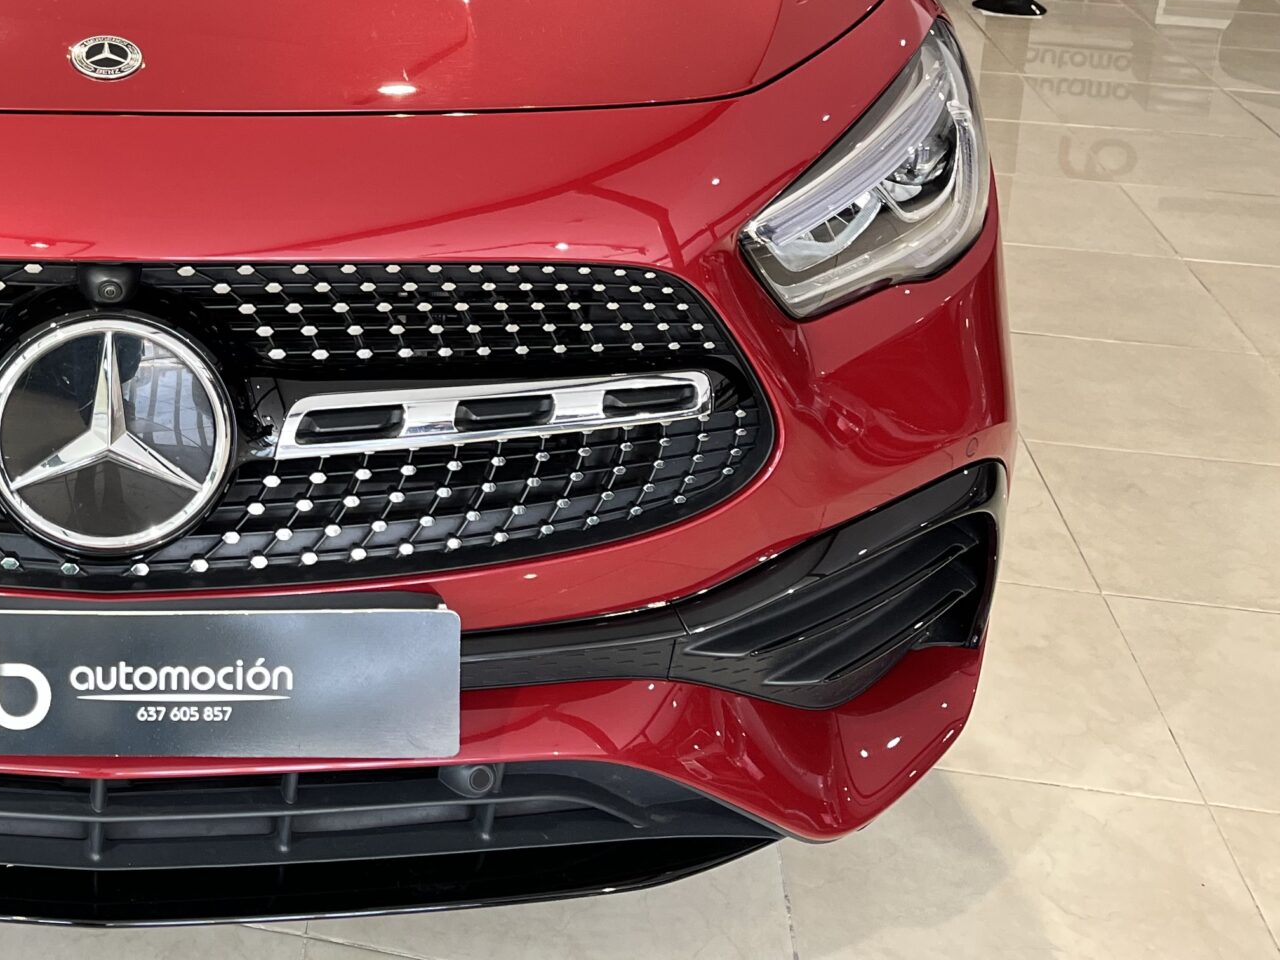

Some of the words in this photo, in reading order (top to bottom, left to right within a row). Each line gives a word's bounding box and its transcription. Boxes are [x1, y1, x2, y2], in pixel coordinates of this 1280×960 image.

[69, 657, 294, 692] automoción
[136, 706, 167, 722] 637
[169, 706, 200, 722] 605
[203, 706, 233, 722] 857
